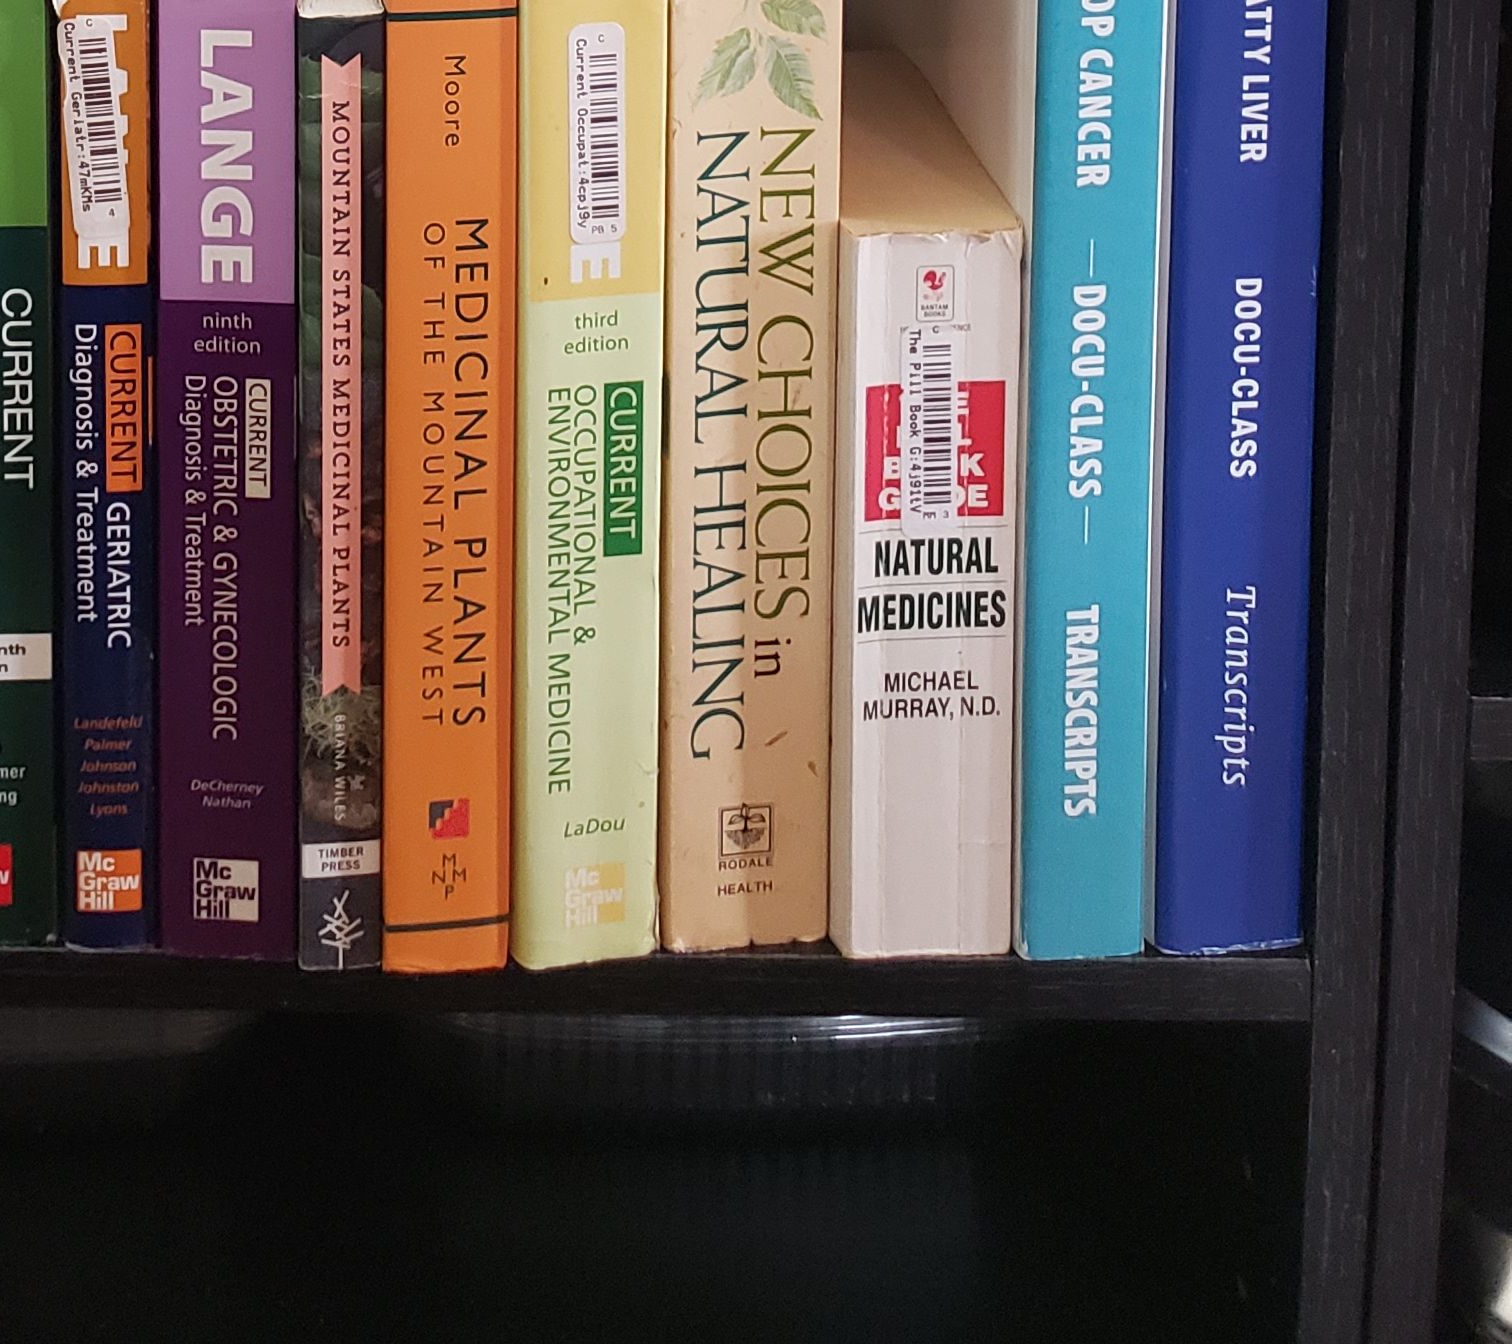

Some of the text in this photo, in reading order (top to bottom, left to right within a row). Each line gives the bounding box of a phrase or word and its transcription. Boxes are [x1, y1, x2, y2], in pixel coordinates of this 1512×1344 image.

[64, 22, 81, 82] Current
[575, 38, 588, 99] Current
[444, 55, 467, 148] Moore
[1076, 49, 1114, 188] CANCER
[1239, 78, 1271, 164] LIVER
[200, 28, 253, 285] LANGE
[611, 223, 618, 233] 5
[202, 312, 253, 330] ninth
[575, 310, 619, 330] third
[194, 336, 261, 355] edition
[564, 335, 629, 354] edition
[909, 328, 922, 355] The
[1, 288, 34, 490] CURRENT
[332, 101, 351, 649] MOUNTAIN STATES MEDICINAL PLANTS
[909, 363, 922, 396] Pill
[1068, 283, 1107, 500] DOCU-CLASS
[1229, 277, 1263, 478] DOCU-CLASS
[753, 127, 816, 678] NEW CHOICES in
[248, 383, 268, 487] CURRENT
[909, 404, 922, 438] Book
[690, 130, 751, 761] NATURAL HEALING
[69, 323, 99, 624] Diagnosis & Treatment
[422, 223, 446, 727] OF THE MOUNTAIN WEST
[453, 218, 489, 727] MEDICINAL PLANTS
[609, 386, 637, 540] CURRENT
[106, 330, 138, 649] CURRENT GERIATRIC
[179, 375, 207, 627] Diagnosis & Treatment
[572, 384, 597, 647] OCCUPATIONAL &
[212, 375, 238, 740] OBSTETRIC & GYNECOLOGIC
[874, 537, 999, 579] NATURAL
[548, 387, 571, 795] ENVIRONMENTAL MEDICINE
[857, 589, 1007, 634] MEDICINES
[883, 669, 979, 695] MICHAEL
[1214, 586, 1257, 787] Transcripts
[74, 714, 143, 729] Landefeld
[863, 696, 1001, 722] MURRAY, N.D.
[1064, 604, 1099, 817] TRANSCRIPTS
[84, 738, 132, 750] Palmer
[80, 759, 137, 772] Johnson
[334, 714, 346, 821] BRIANA WILES
[78, 779, 139, 794] Johnston
[190, 778, 264, 796] DeCherney
[202, 795, 251, 809] Nathan
[90, 803, 128, 818] Lyons
[564, 817, 626, 838] LaDou
[79, 851, 115, 872] Mc
[318, 846, 364, 859] TIMBER
[321, 860, 361, 872] PRESS
[79, 872, 140, 891] Graw
[196, 861, 231, 880] Mc
[565, 868, 600, 888] Mc
[79, 891, 115, 911] Hill
[196, 880, 256, 901] Graw
[565, 887, 623, 908] Graw
[717, 880, 773, 896] HEALTH
[196, 898, 230, 918] Hill
